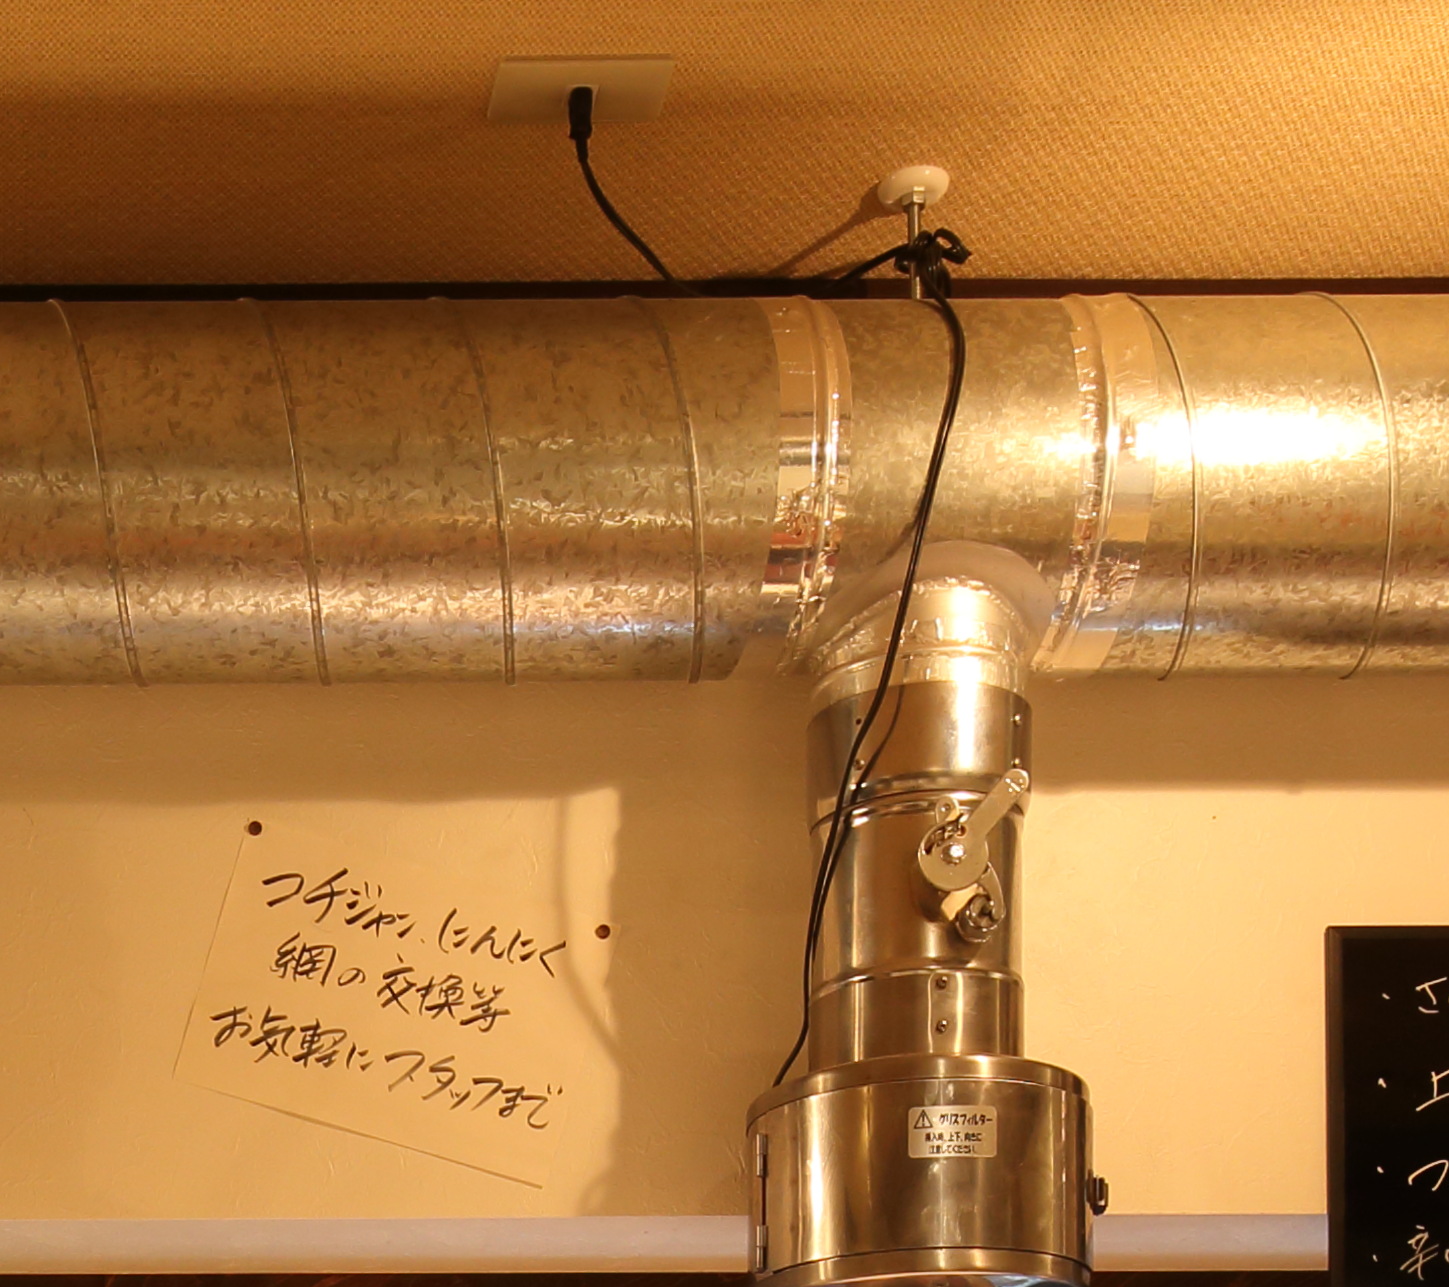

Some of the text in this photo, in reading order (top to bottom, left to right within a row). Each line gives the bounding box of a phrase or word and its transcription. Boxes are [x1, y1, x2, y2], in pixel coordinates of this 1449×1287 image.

[209, 1005, 564, 1129] お気軽にスタッフまで
